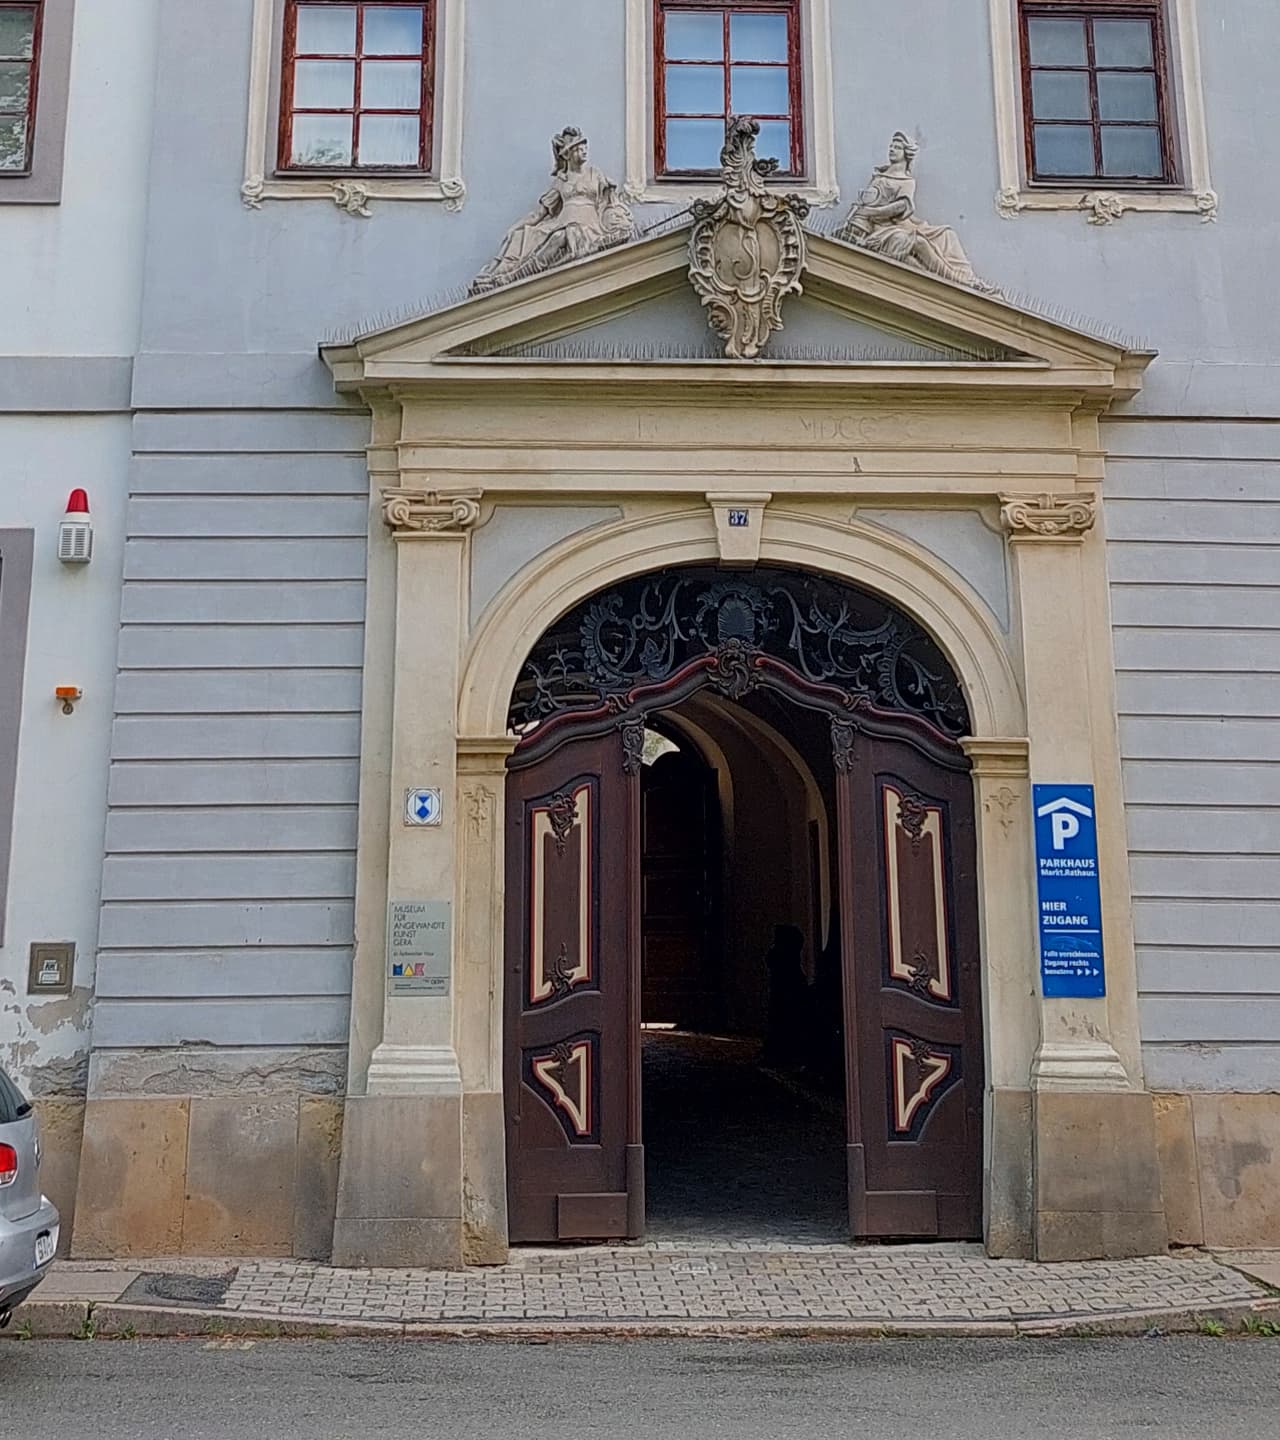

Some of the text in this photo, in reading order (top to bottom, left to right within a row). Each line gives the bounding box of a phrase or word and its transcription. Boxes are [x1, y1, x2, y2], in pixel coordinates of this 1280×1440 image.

[730, 511, 748, 525] 37
[1051, 812, 1080, 850] P
[1040, 858, 1096, 868] PARKHAUS
[393, 905, 426, 913] MUSEUM
[1042, 901, 1067, 911] HIER
[1042, 915, 1089, 925] ZUGANG
[393, 921, 446, 930] ANGEWANDTE
[393, 930, 417, 938] KUNST
